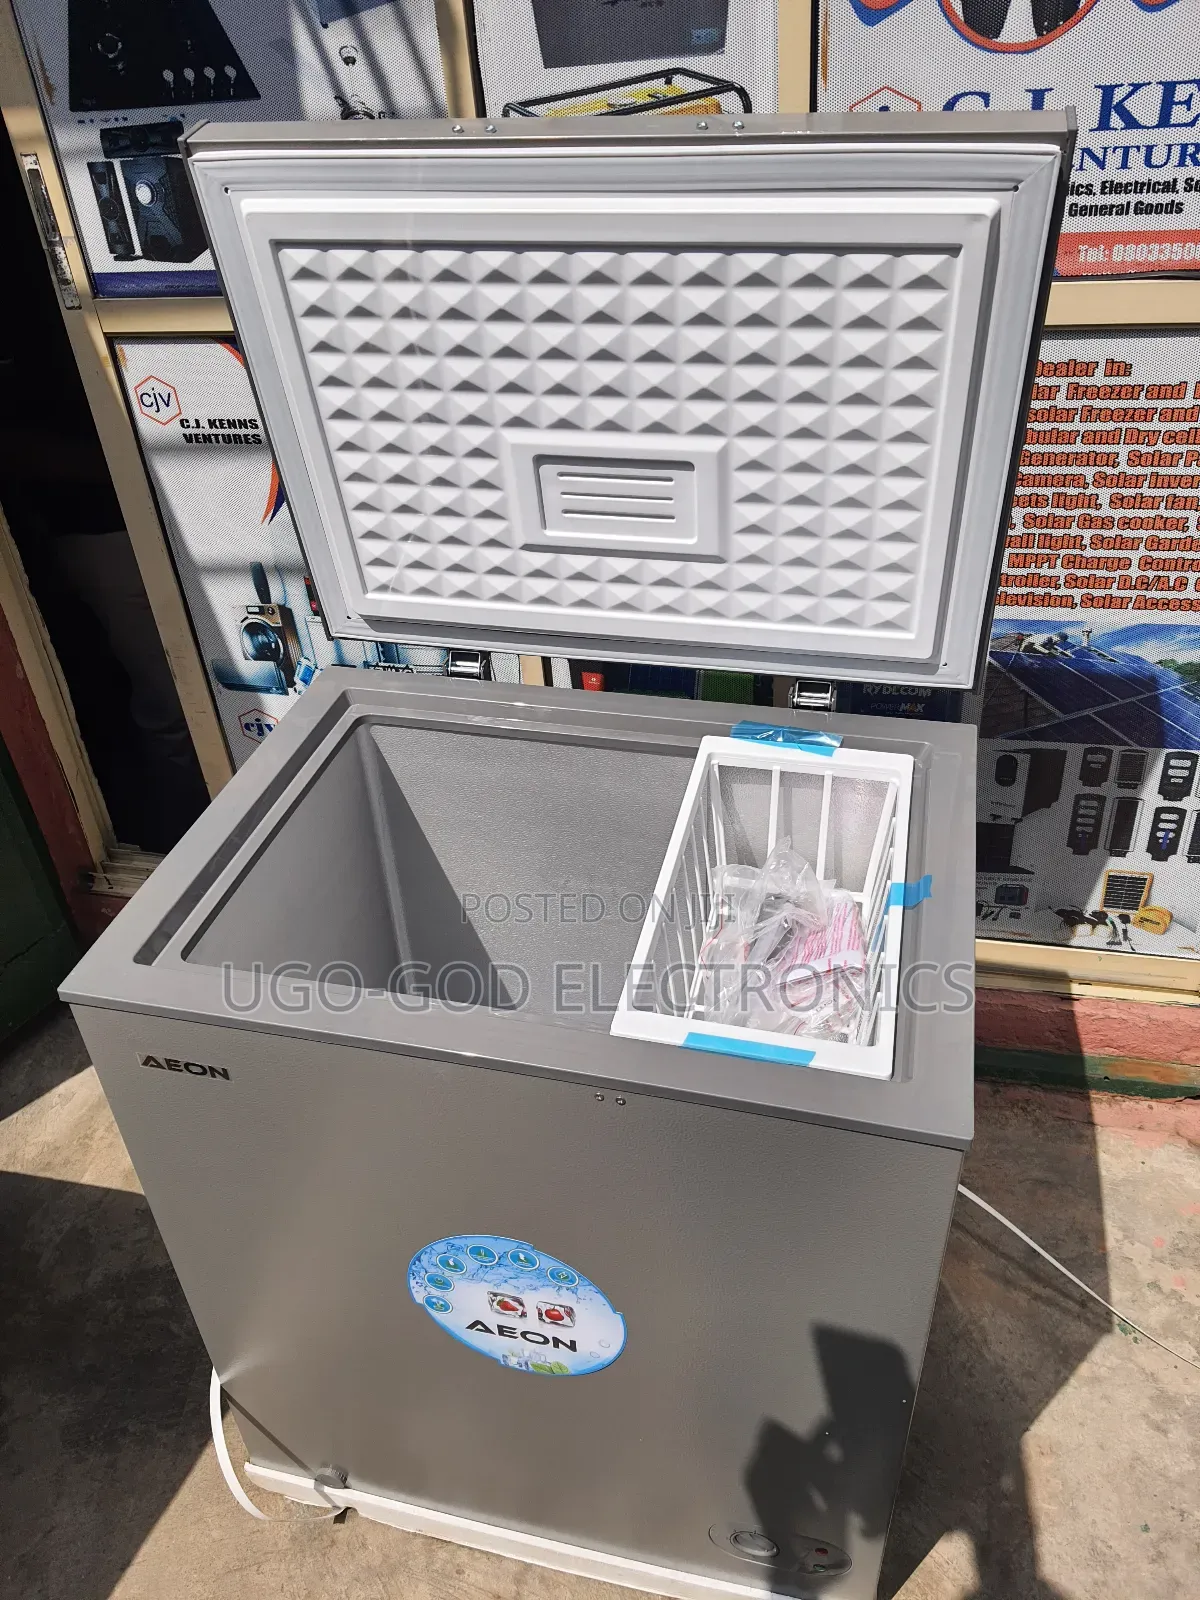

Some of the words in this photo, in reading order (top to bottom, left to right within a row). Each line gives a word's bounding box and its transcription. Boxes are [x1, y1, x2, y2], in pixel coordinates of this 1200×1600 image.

[1072, 143, 1200, 172] NTUR
[1100, 178, 1180, 195] Electrical,
[1068, 201, 1131, 217] General
[1133, 200, 1185, 216] Goods
[1104, 359, 1133, 377] in:
[1066, 382, 1144, 400] Freezer
[1145, 381, 1188, 400] and
[139, 387, 171, 413] cjv
[1080, 405, 1157, 423] Freezer
[1158, 404, 1200, 423] and
[207, 419, 260, 430] KENNS
[183, 433, 262, 445] VENTURES
[1081, 428, 1122, 445] and
[1123, 428, 1162, 447] Dry
[1127, 450, 1183, 467] Solar
[1092, 472, 1147, 488] Solar
[1051, 492, 1102, 510] light,
[1109, 493, 1165, 510] Solar
[1023, 512, 1075, 529] Solar
[1077, 513, 1115, 529] Gas
[1117, 515, 1189, 532] cooker,
[1037, 533, 1087, 551] light,
[1089, 534, 1143, 550] Solar
[1008, 553, 1060, 569] MPPT
[1061, 554, 1132, 572] Charge
[1064, 573, 1116, 589] Solar
[1080, 593, 1132, 609] Solar
[141, 1055, 230, 1081] AEON
[465, 1318, 578, 1353] AEON
